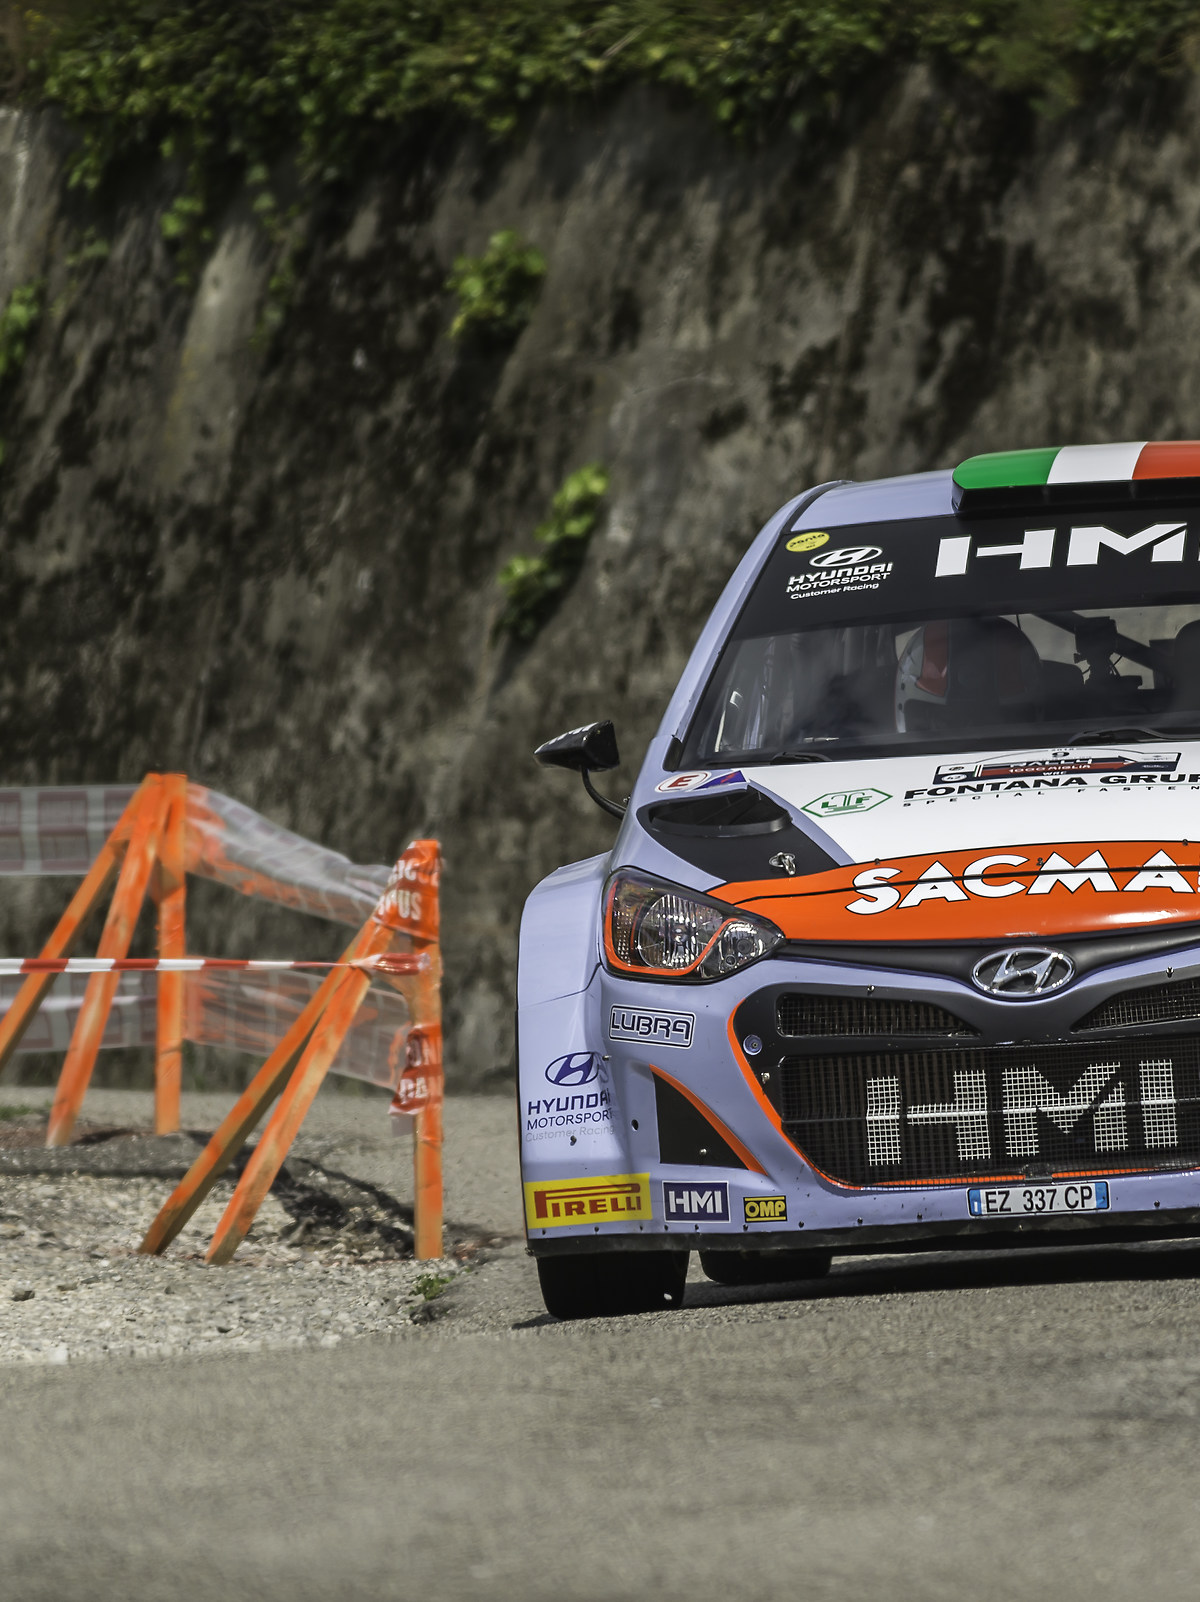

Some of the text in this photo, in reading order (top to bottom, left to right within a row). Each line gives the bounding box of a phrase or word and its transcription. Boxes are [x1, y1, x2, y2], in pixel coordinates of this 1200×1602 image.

[786, 572, 891, 593] MOTORSPORT
[788, 562, 893, 585] HYUNDAI
[790, 582, 880, 600] Customer Racing
[667, 774, 700, 788] E
[904, 776, 1088, 800] FONTANA
[903, 790, 1045, 807] SPECIAL
[845, 848, 1196, 915] SACMA
[611, 1011, 692, 1041] LUBRA
[528, 1088, 611, 1116] HYUNDAI
[866, 1058, 1178, 1166] HMI
[526, 1109, 615, 1131] MOTORSPORT
[525, 1123, 615, 1143] Customer Racing
[534, 1183, 642, 1219] PIRELLI
[668, 1190, 723, 1215] HMI
[745, 1201, 786, 1218] OMP
[984, 1184, 1093, 1214] EZ 337 CP
